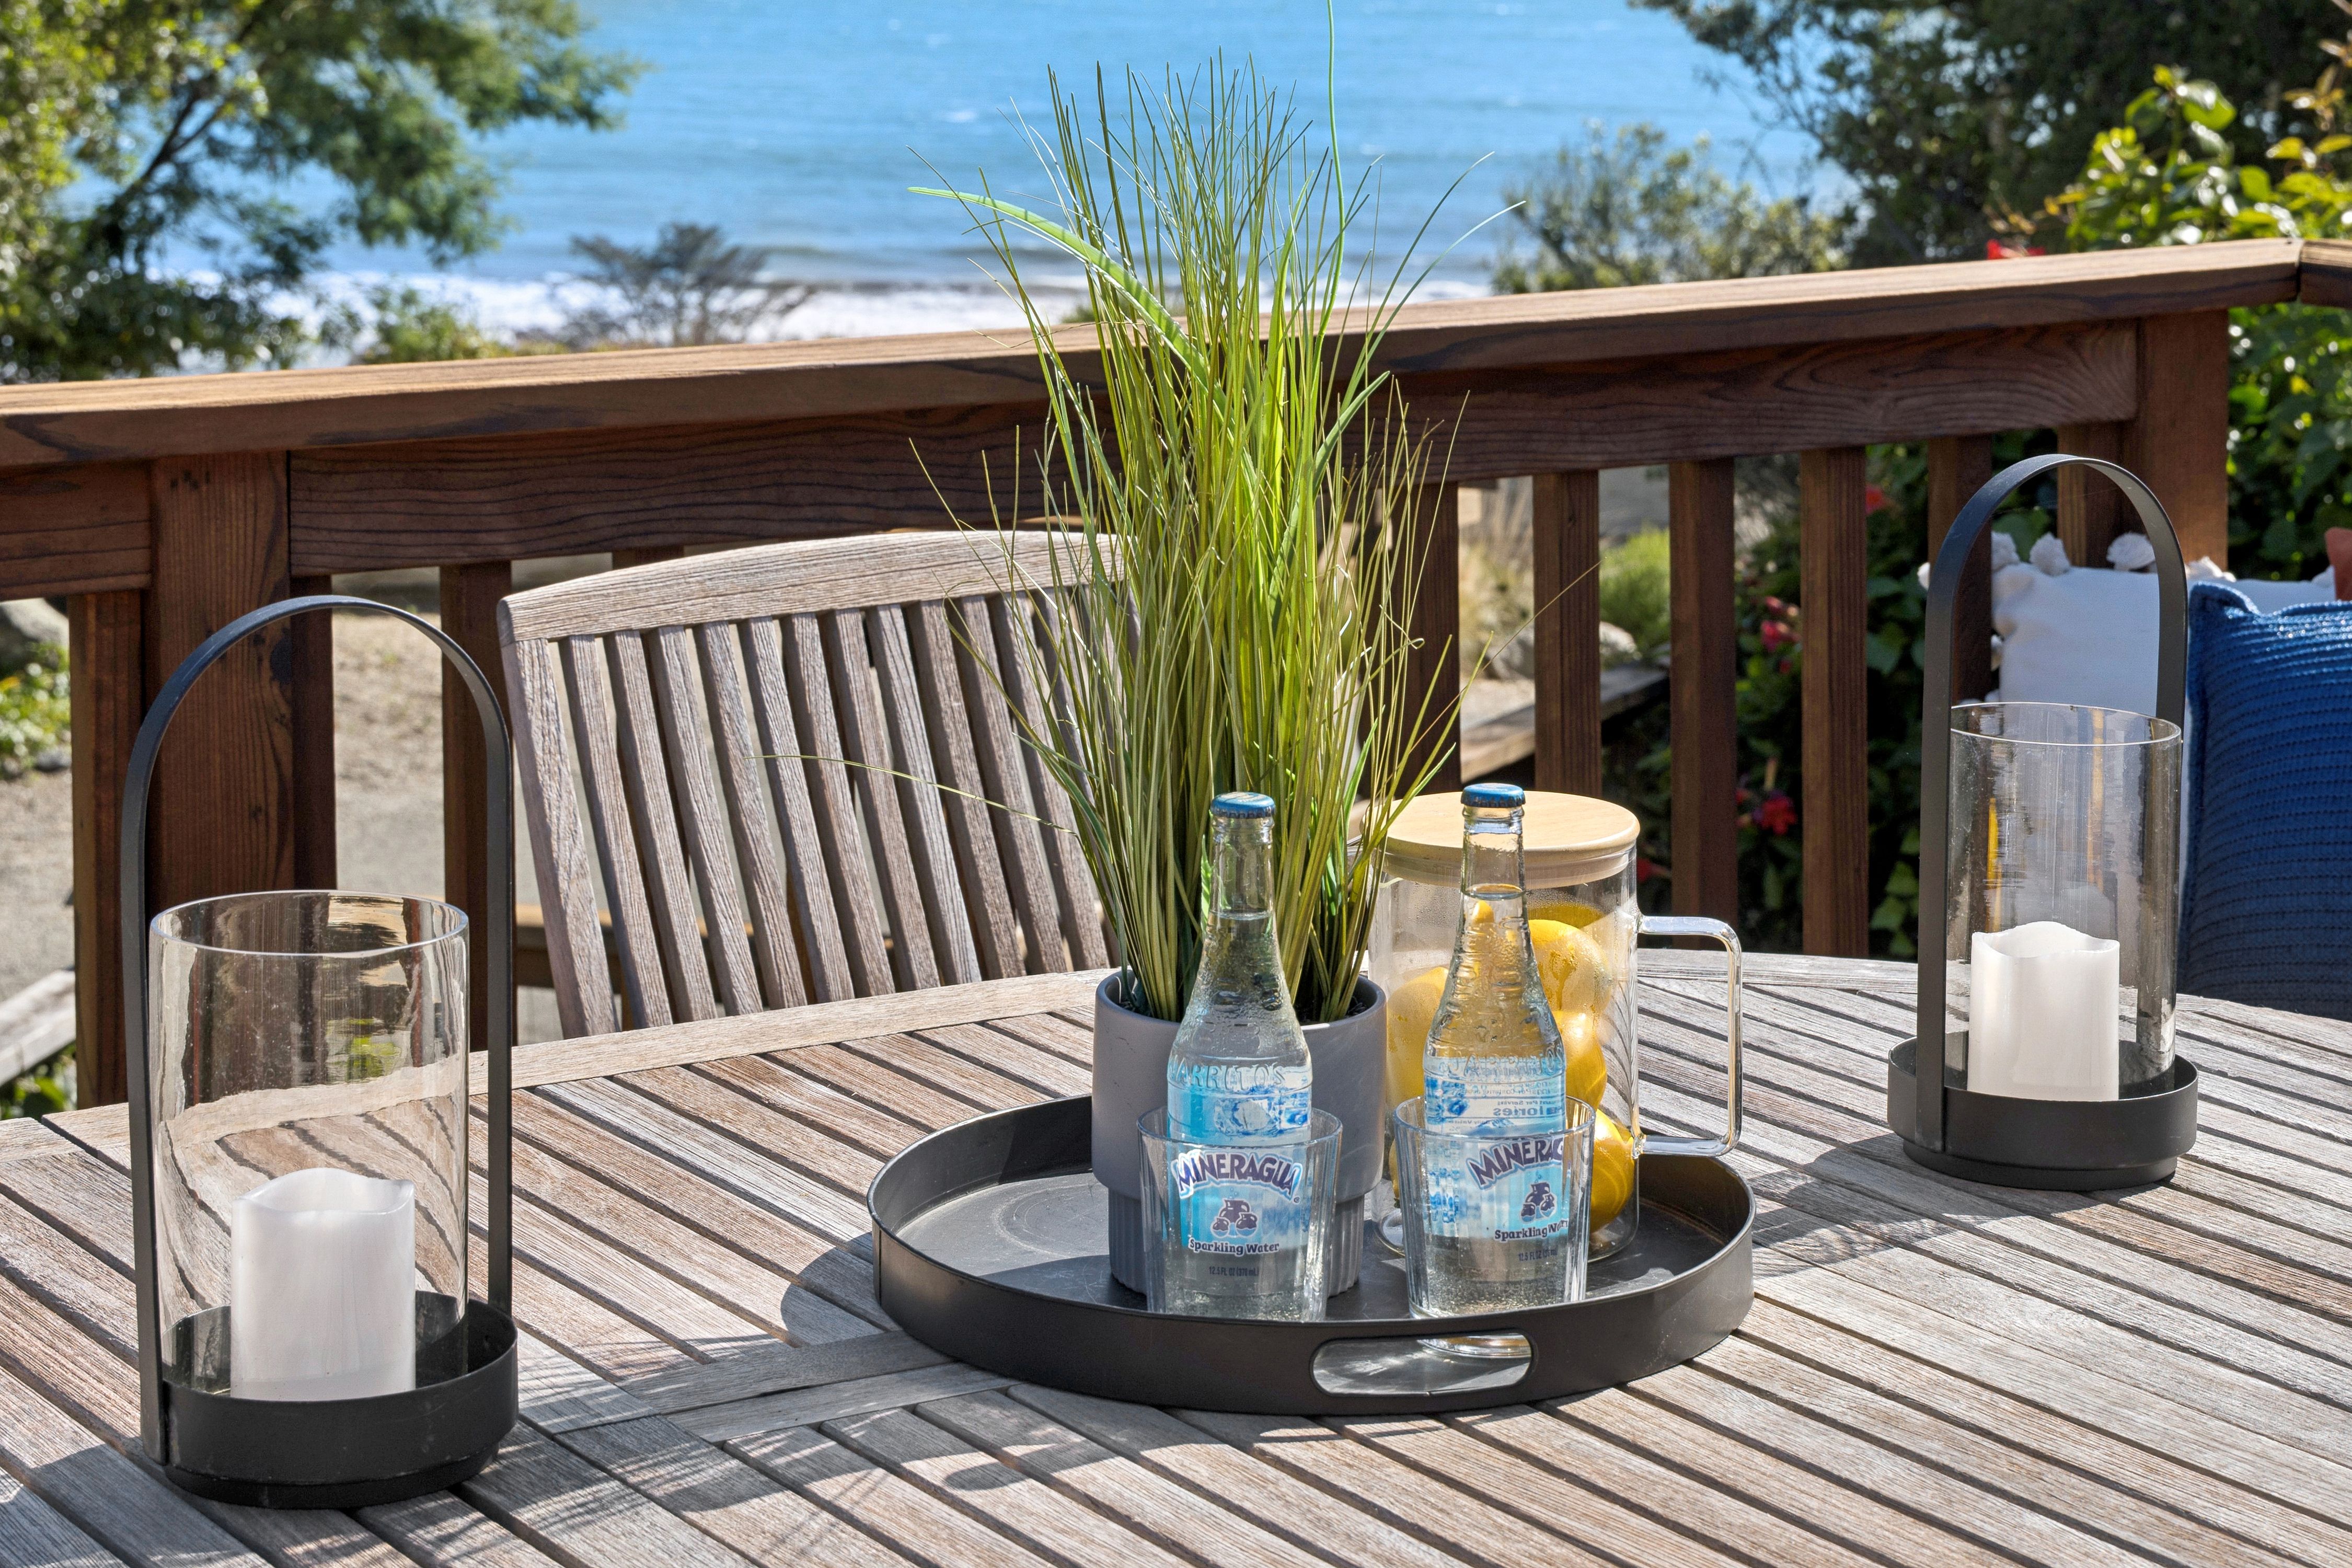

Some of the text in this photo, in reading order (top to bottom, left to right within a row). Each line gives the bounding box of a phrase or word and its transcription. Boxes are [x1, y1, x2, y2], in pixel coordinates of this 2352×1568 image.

[1175, 1154, 1297, 1195] MINERAGUA
[1495, 1226, 1547, 1242] Sparkling
[1190, 1239, 1279, 1254] Sparkling Water
